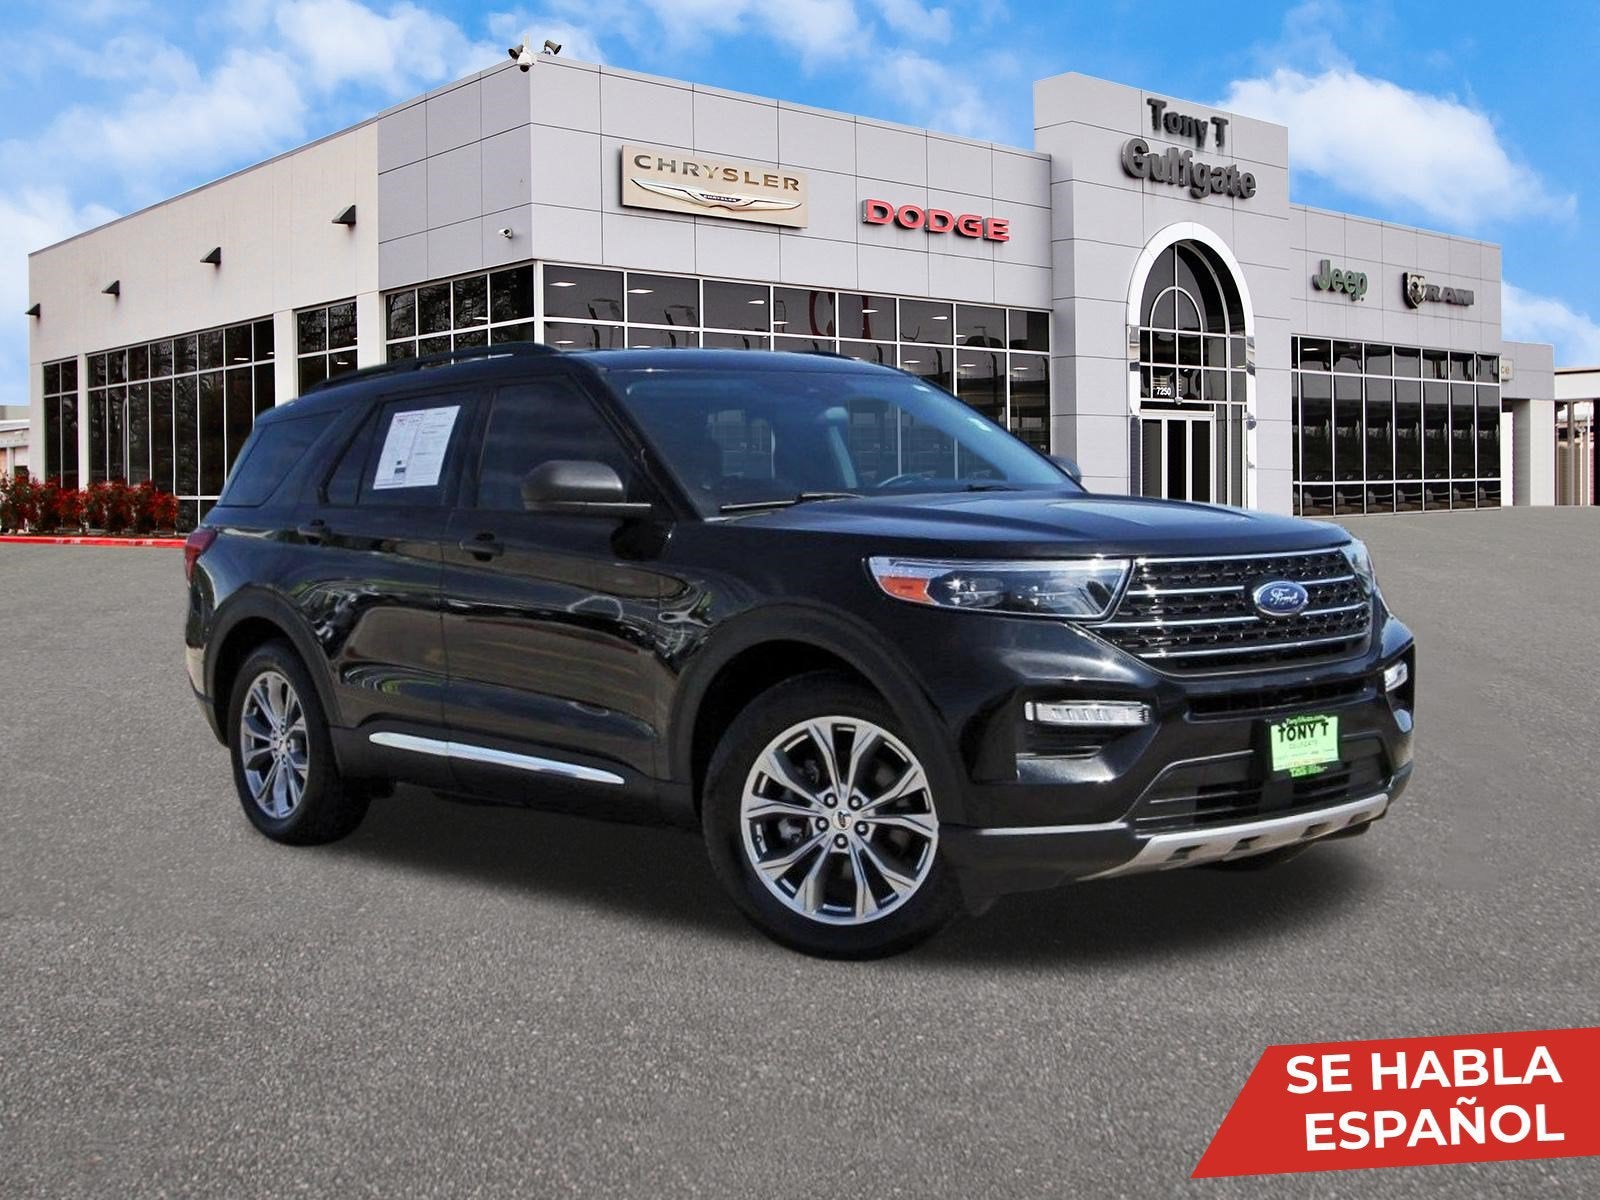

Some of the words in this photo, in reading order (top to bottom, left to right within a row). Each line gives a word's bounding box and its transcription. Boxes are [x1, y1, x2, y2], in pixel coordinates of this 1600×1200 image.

[1147, 97, 1208, 147] Tony
[1210, 116, 1229, 147] T
[633, 154, 800, 192] CHRYSLER
[1121, 137, 1256, 199] Gulfgate
[864, 198, 1010, 242] DODGE
[1313, 259, 1368, 301] Jeep
[1425, 284, 1474, 306] RAM
[1156, 387, 1172, 396] 7250
[1269, 588, 1298, 605] Ford
[1278, 723, 1316, 742] TONY
[1321, 722, 1329, 736] T
